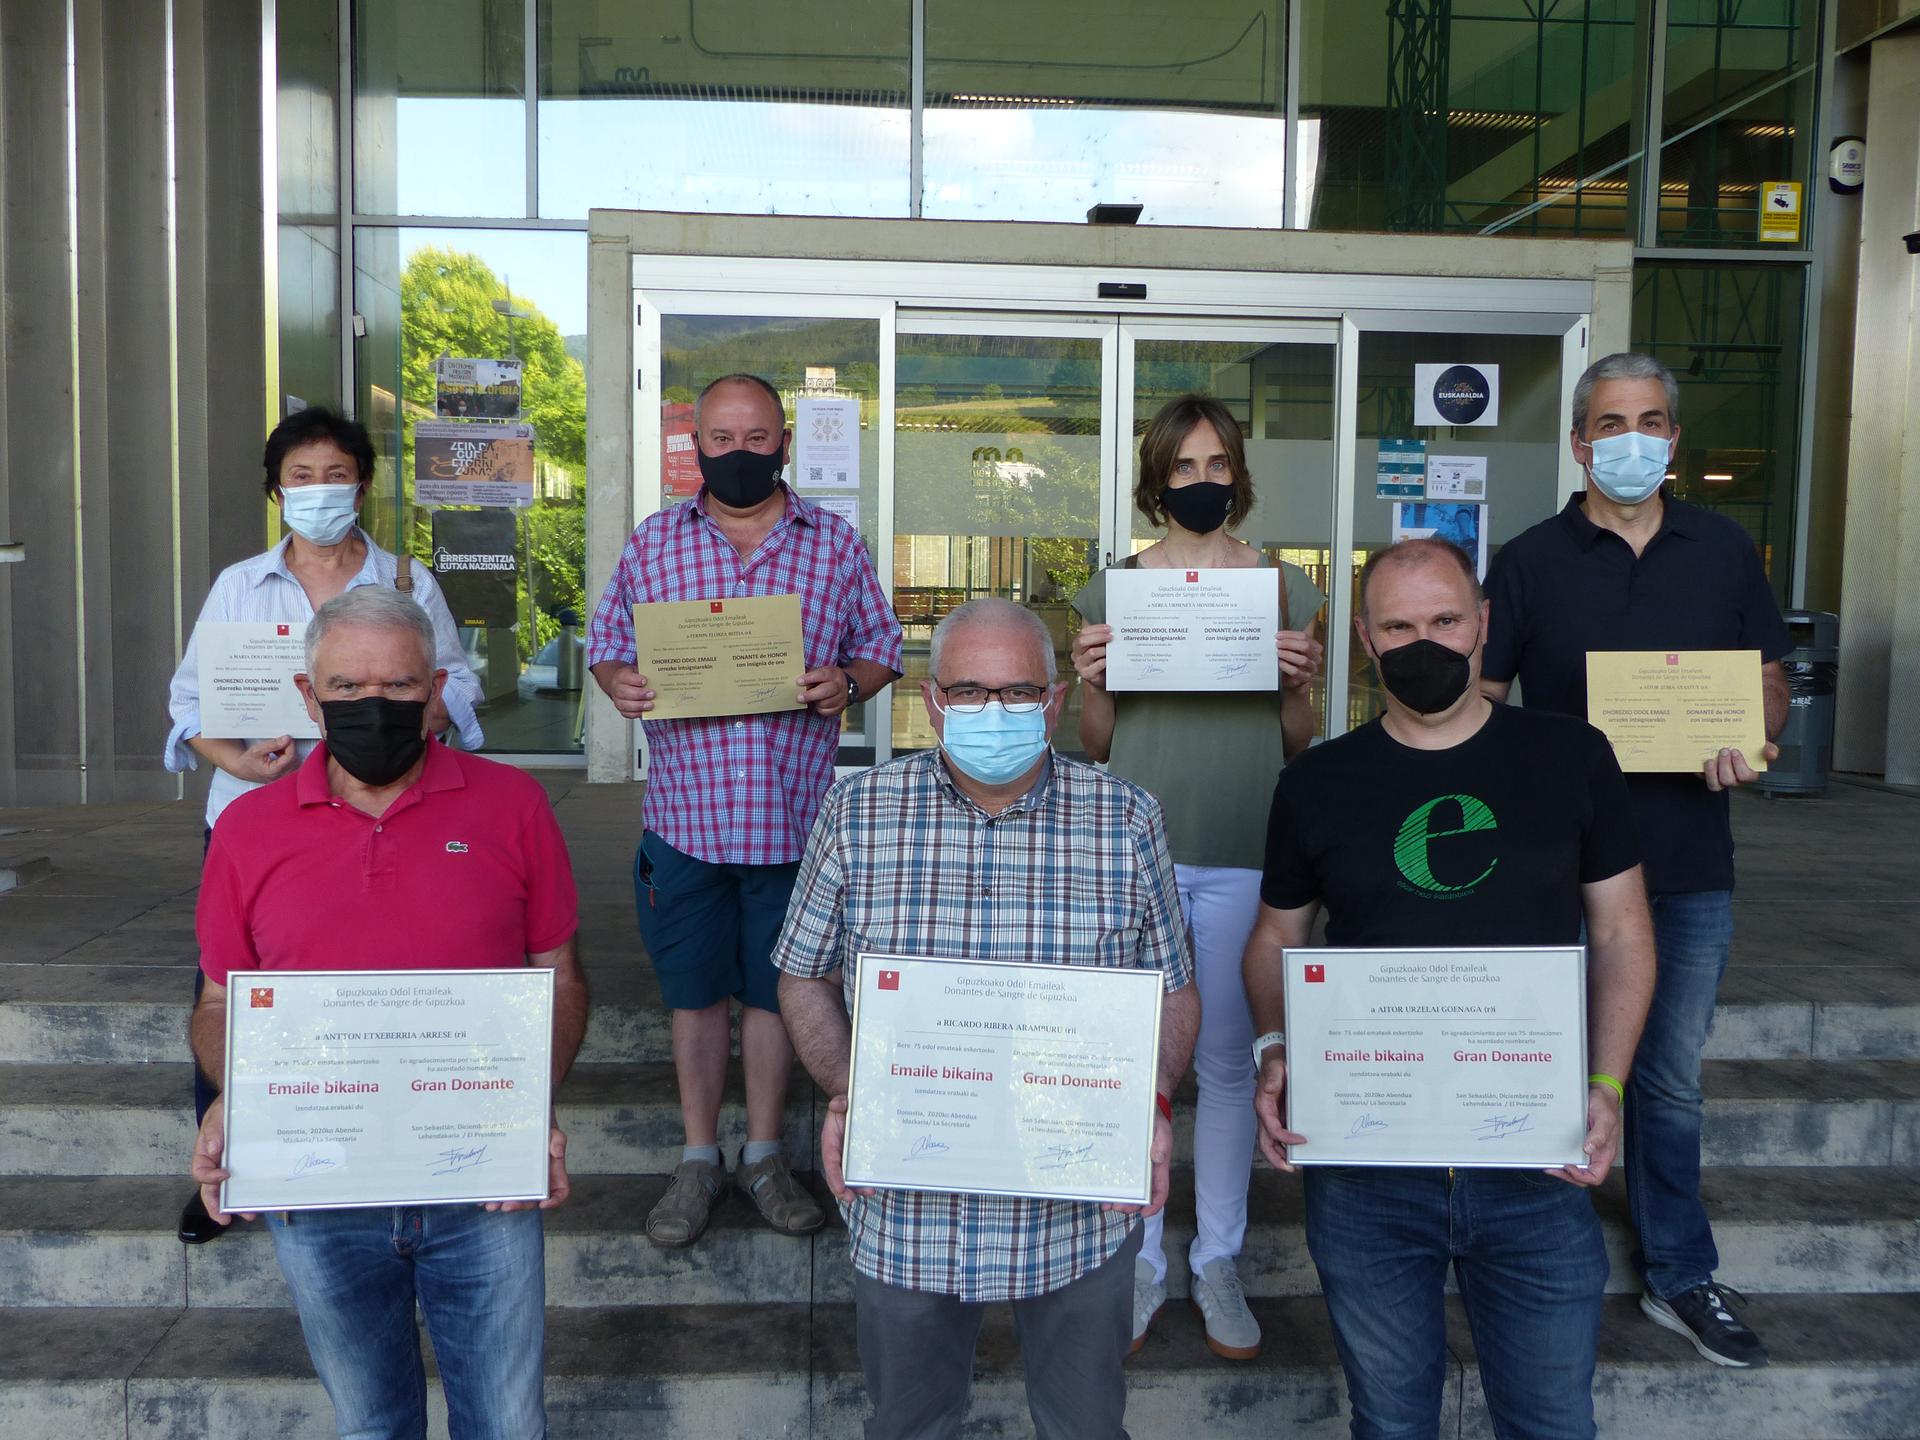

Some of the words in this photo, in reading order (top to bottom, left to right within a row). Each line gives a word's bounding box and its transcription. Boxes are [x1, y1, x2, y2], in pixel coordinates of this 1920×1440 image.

[450, 442, 476, 450] ZEIN
[440, 554, 515, 563] ERRESISTENTZIA
[440, 562, 468, 571] KUTXA
[469, 562, 515, 571] NAZIONALA
[1380, 964, 1428, 974] Gipuzkoako
[1429, 964, 1448, 973] Odol
[1451, 964, 1488, 973] Emaileak
[957, 976, 1006, 989] Gipuzkoako
[1006, 978, 1026, 989] Odol
[1028, 980, 1067, 991] Emaileak
[1369, 974, 1407, 982] Donantes
[1409, 974, 1419, 982] de
[1421, 974, 1449, 984] Sangre
[1450, 974, 1461, 982] de
[1462, 974, 1501, 984] Gipuzkoa
[336, 988, 389, 998] Gipuzkoako
[390, 987, 411, 997] Odol
[413, 987, 453, 996] Emaileak
[945, 985, 983, 996] Donantes
[985, 988, 996, 997] de
[997, 989, 1026, 1001] Sangre
[1027, 990, 1038, 999] de
[1039, 991, 1079, 1004] Gipuzkoa
[324, 999, 366, 1007] Donantes
[368, 998, 379, 1007] de
[381, 998, 411, 1009] Sangre
[412, 998, 424, 1006] de
[425, 997, 467, 1008] Gipuzkoa
[1378, 1005, 1403, 1013] AITOR
[1406, 1005, 1440, 1013] URZELAI
[1441, 1005, 1482, 1013] GOENAGA
[944, 1019, 982, 1029] RICARDO
[984, 1021, 1014, 1031] RIBERA
[323, 1032, 361, 1041] ANTTON
[364, 1031, 418, 1041] ETXEBERRIA
[419, 1031, 453, 1040] ARRESE
[1324, 1049, 1371, 1062] Emaile
[1374, 1049, 1425, 1062] bikaina
[1452, 1050, 1487, 1063] Gran
[1491, 1050, 1553, 1063] Donante
[890, 1062, 939, 1078] Emaile
[942, 1065, 994, 1082] bikaina
[410, 1078, 447, 1092] Gran
[451, 1076, 516, 1091] Donante
[1022, 1070, 1058, 1086] Gran
[1061, 1073, 1124, 1090] Donante
[268, 1081, 321, 1096] Emaile
[325, 1079, 381, 1094] bikaina
